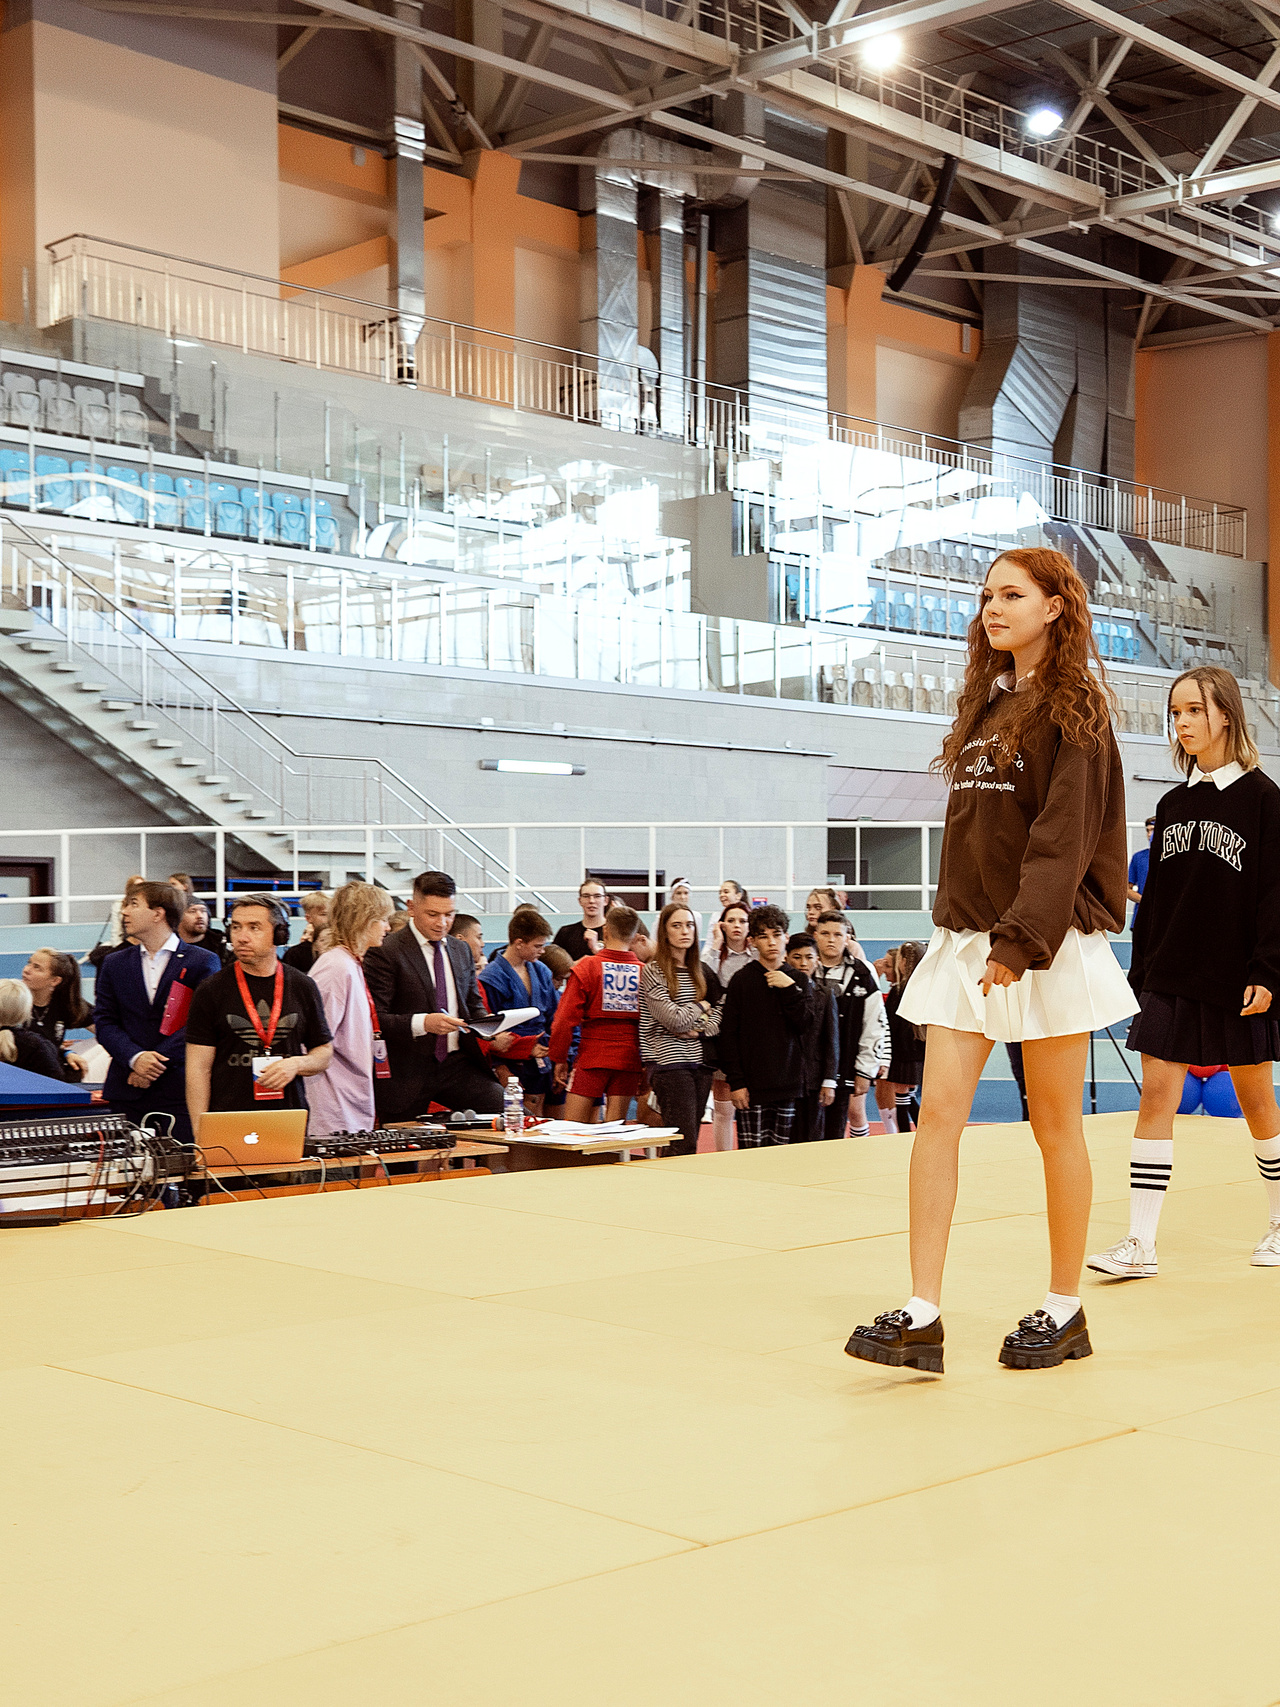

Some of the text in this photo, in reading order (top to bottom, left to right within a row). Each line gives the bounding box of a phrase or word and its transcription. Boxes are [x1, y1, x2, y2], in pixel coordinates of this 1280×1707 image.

[1160, 820, 1247, 872] EW YORK
[604, 963, 638, 973] SAMBO
[603, 973, 638, 992] RUS
